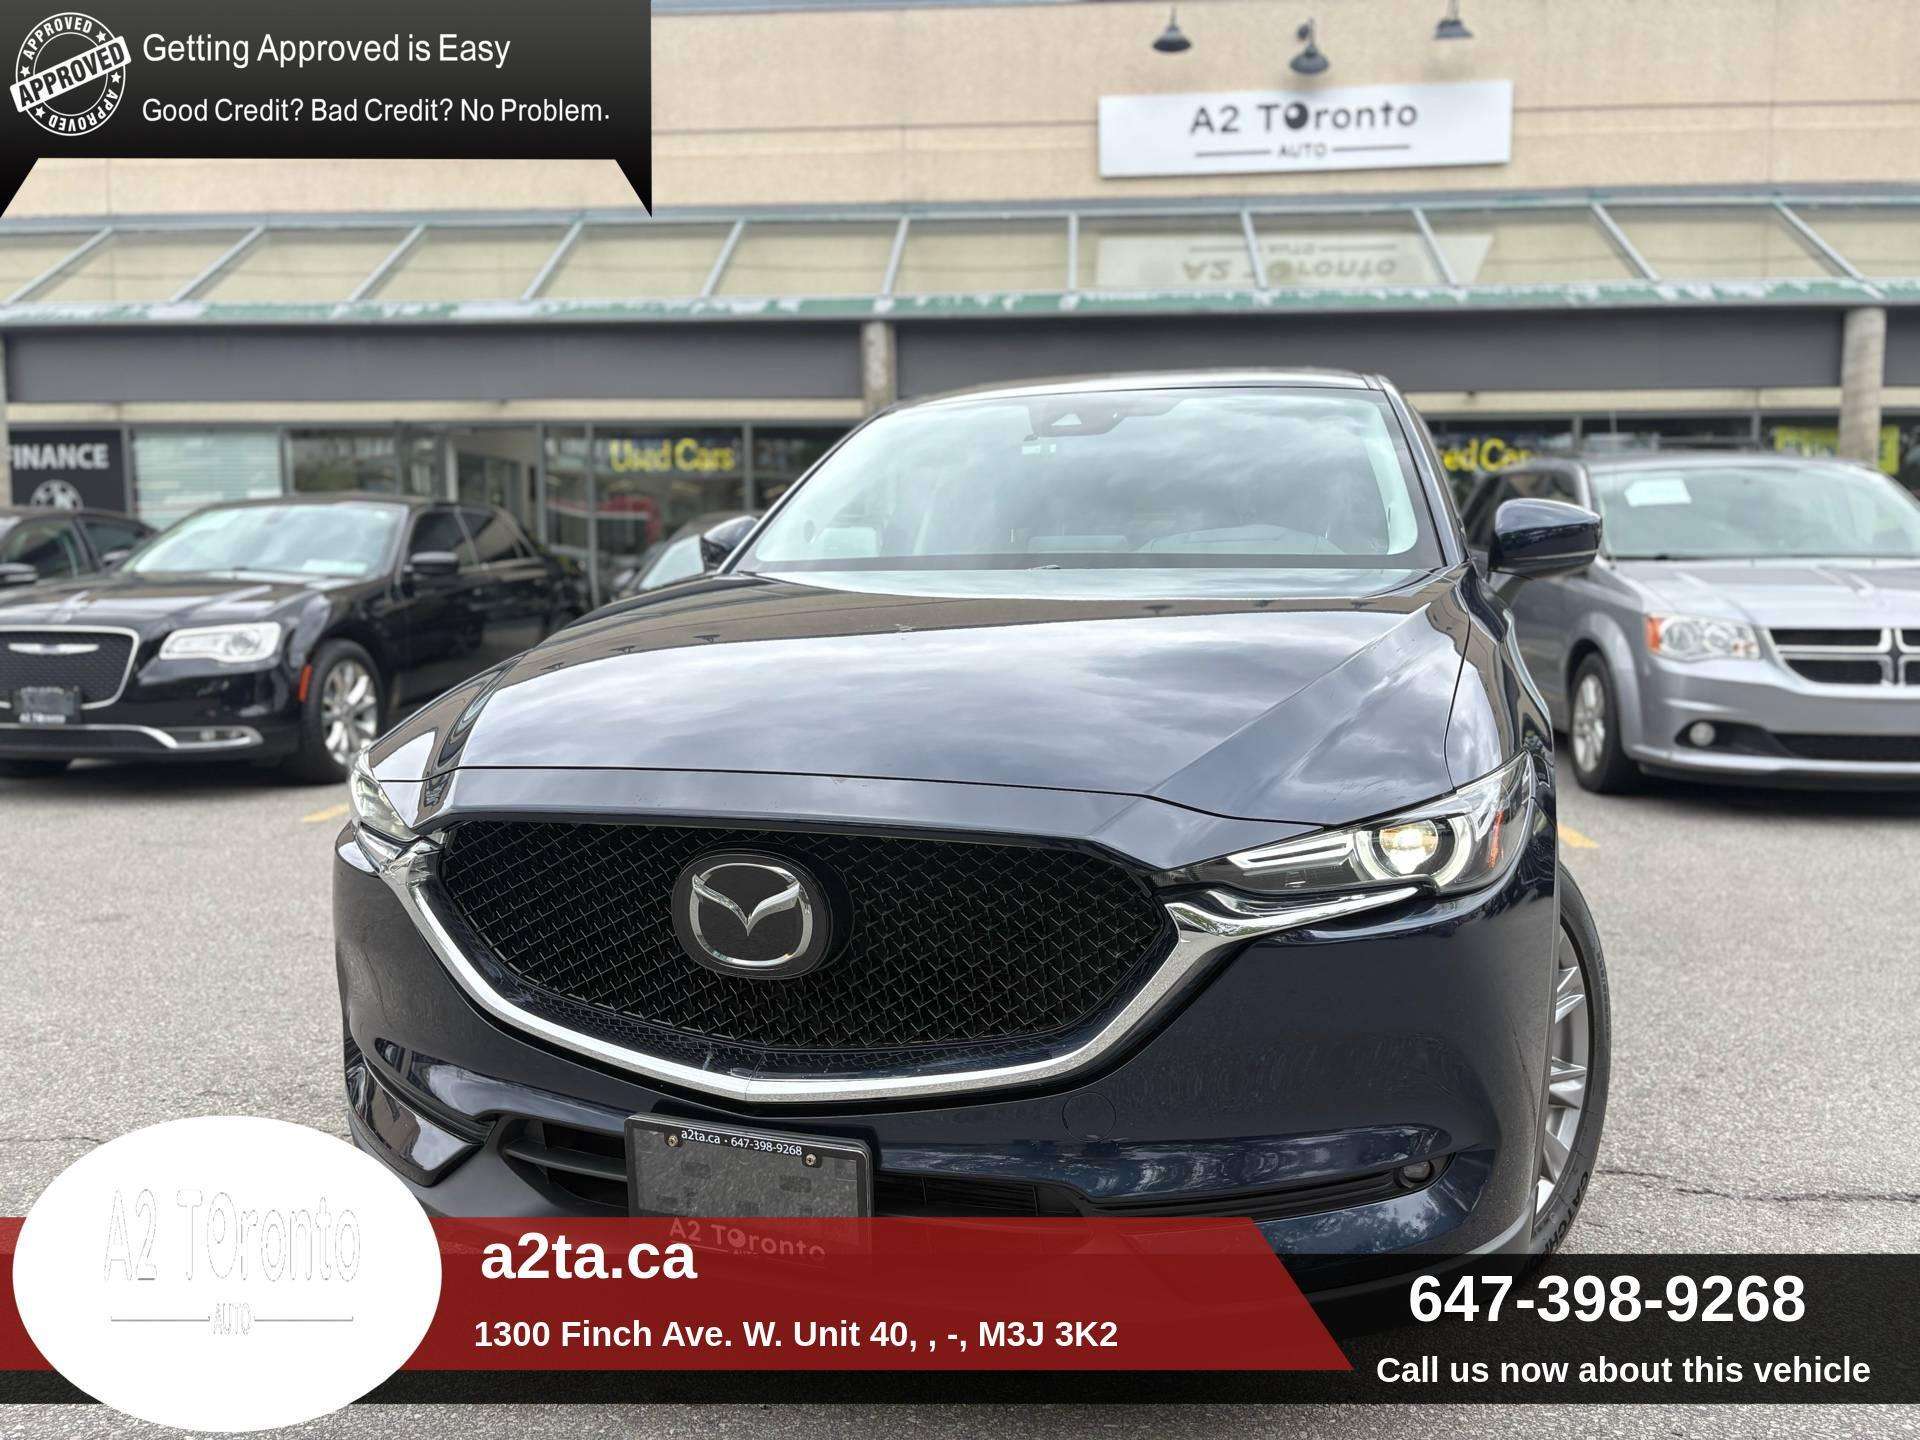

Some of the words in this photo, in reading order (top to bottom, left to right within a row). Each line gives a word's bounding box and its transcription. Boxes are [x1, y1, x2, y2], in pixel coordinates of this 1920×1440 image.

[1191, 105, 1240, 136] A2
[1278, 142, 1328, 158] AUTO
[609, 438, 672, 472] Used
[675, 437, 736, 471] Cars
[1443, 438, 1478, 472] ed
[681, 1129, 721, 1144] a2ta.ca
[730, 1136, 803, 1156] 647-398-9268
[669, 1217, 701, 1242] A2
